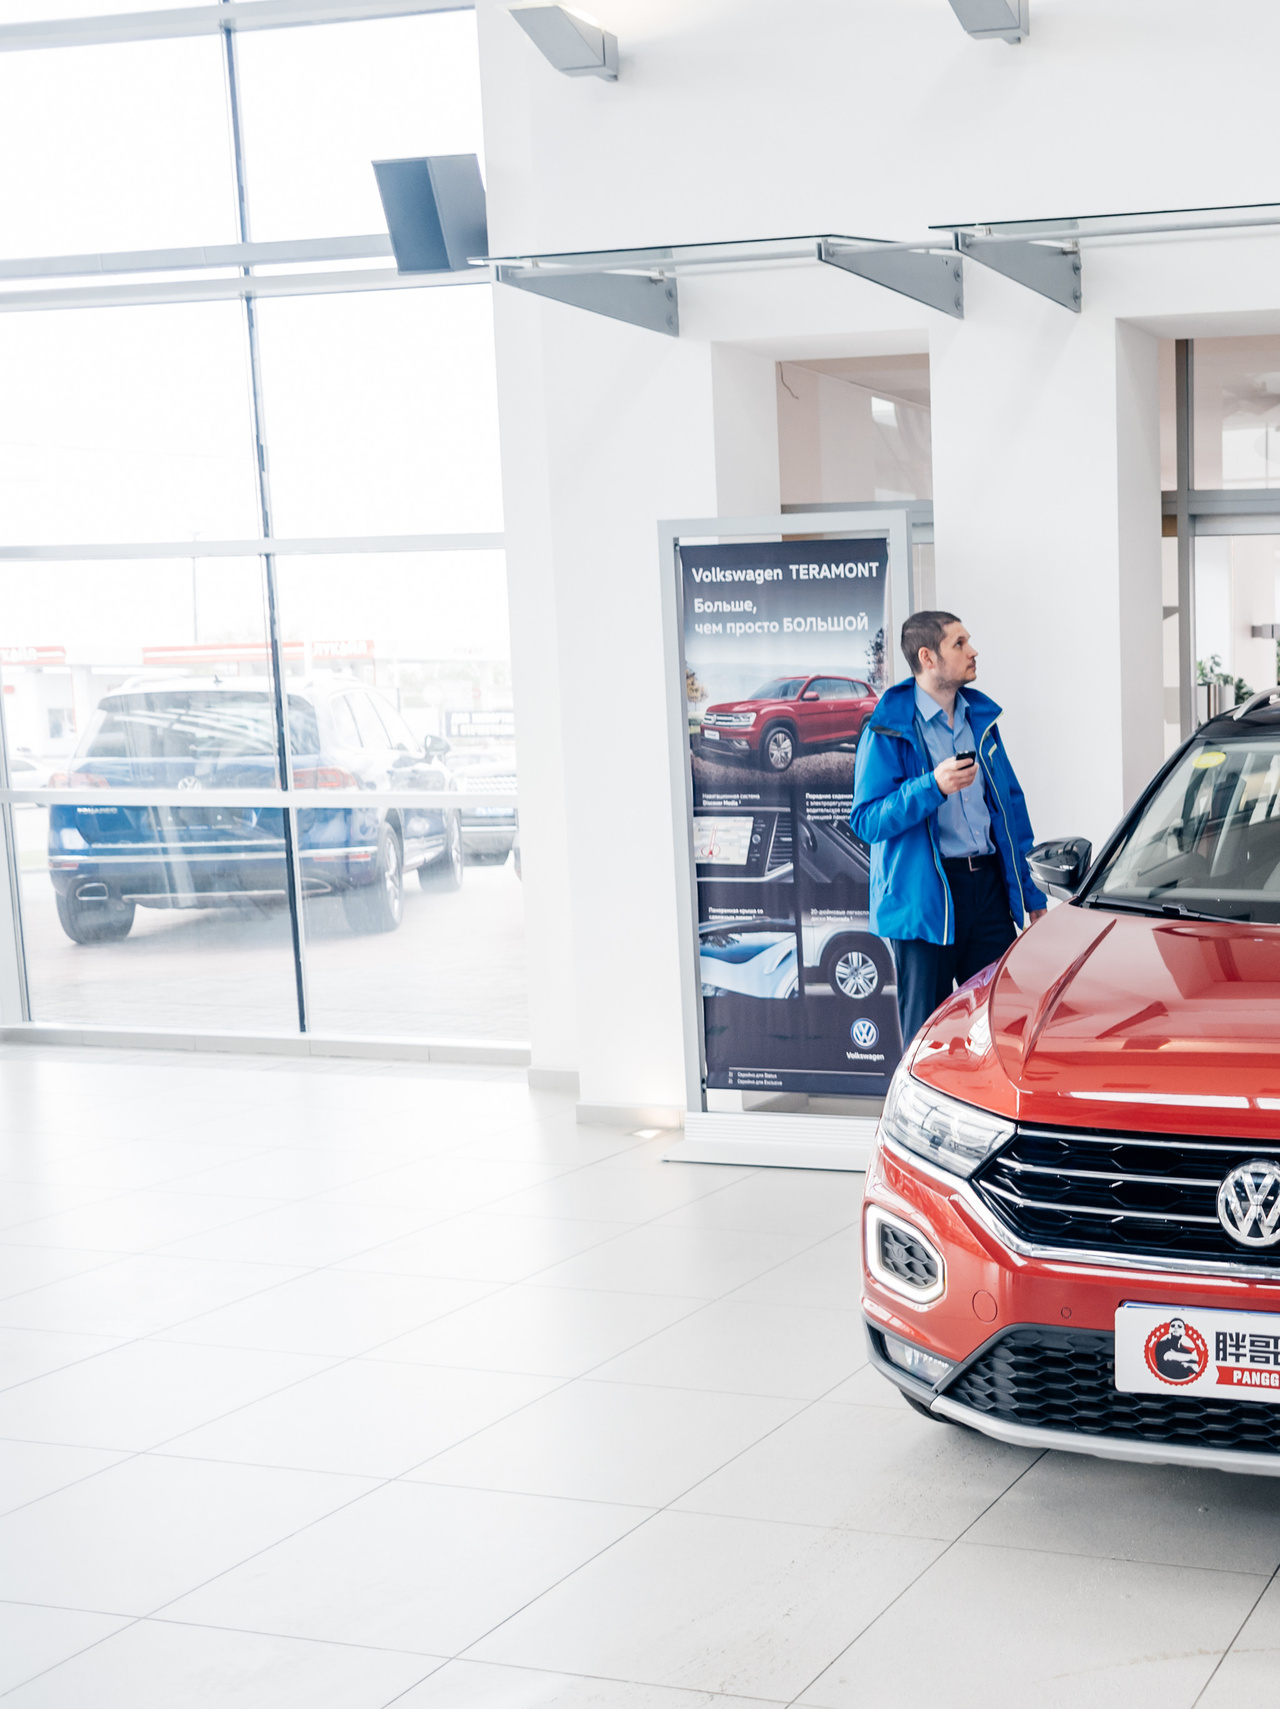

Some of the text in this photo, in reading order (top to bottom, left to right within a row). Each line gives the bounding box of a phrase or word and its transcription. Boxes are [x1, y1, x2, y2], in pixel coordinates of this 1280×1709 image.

[691, 562, 879, 584] Volkswagen TERAMONT
[694, 598, 757, 615] Больше,
[695, 612, 868, 637] чем просто БОЛЬШОЙ
[846, 1051, 885, 1062] Volkswagen
